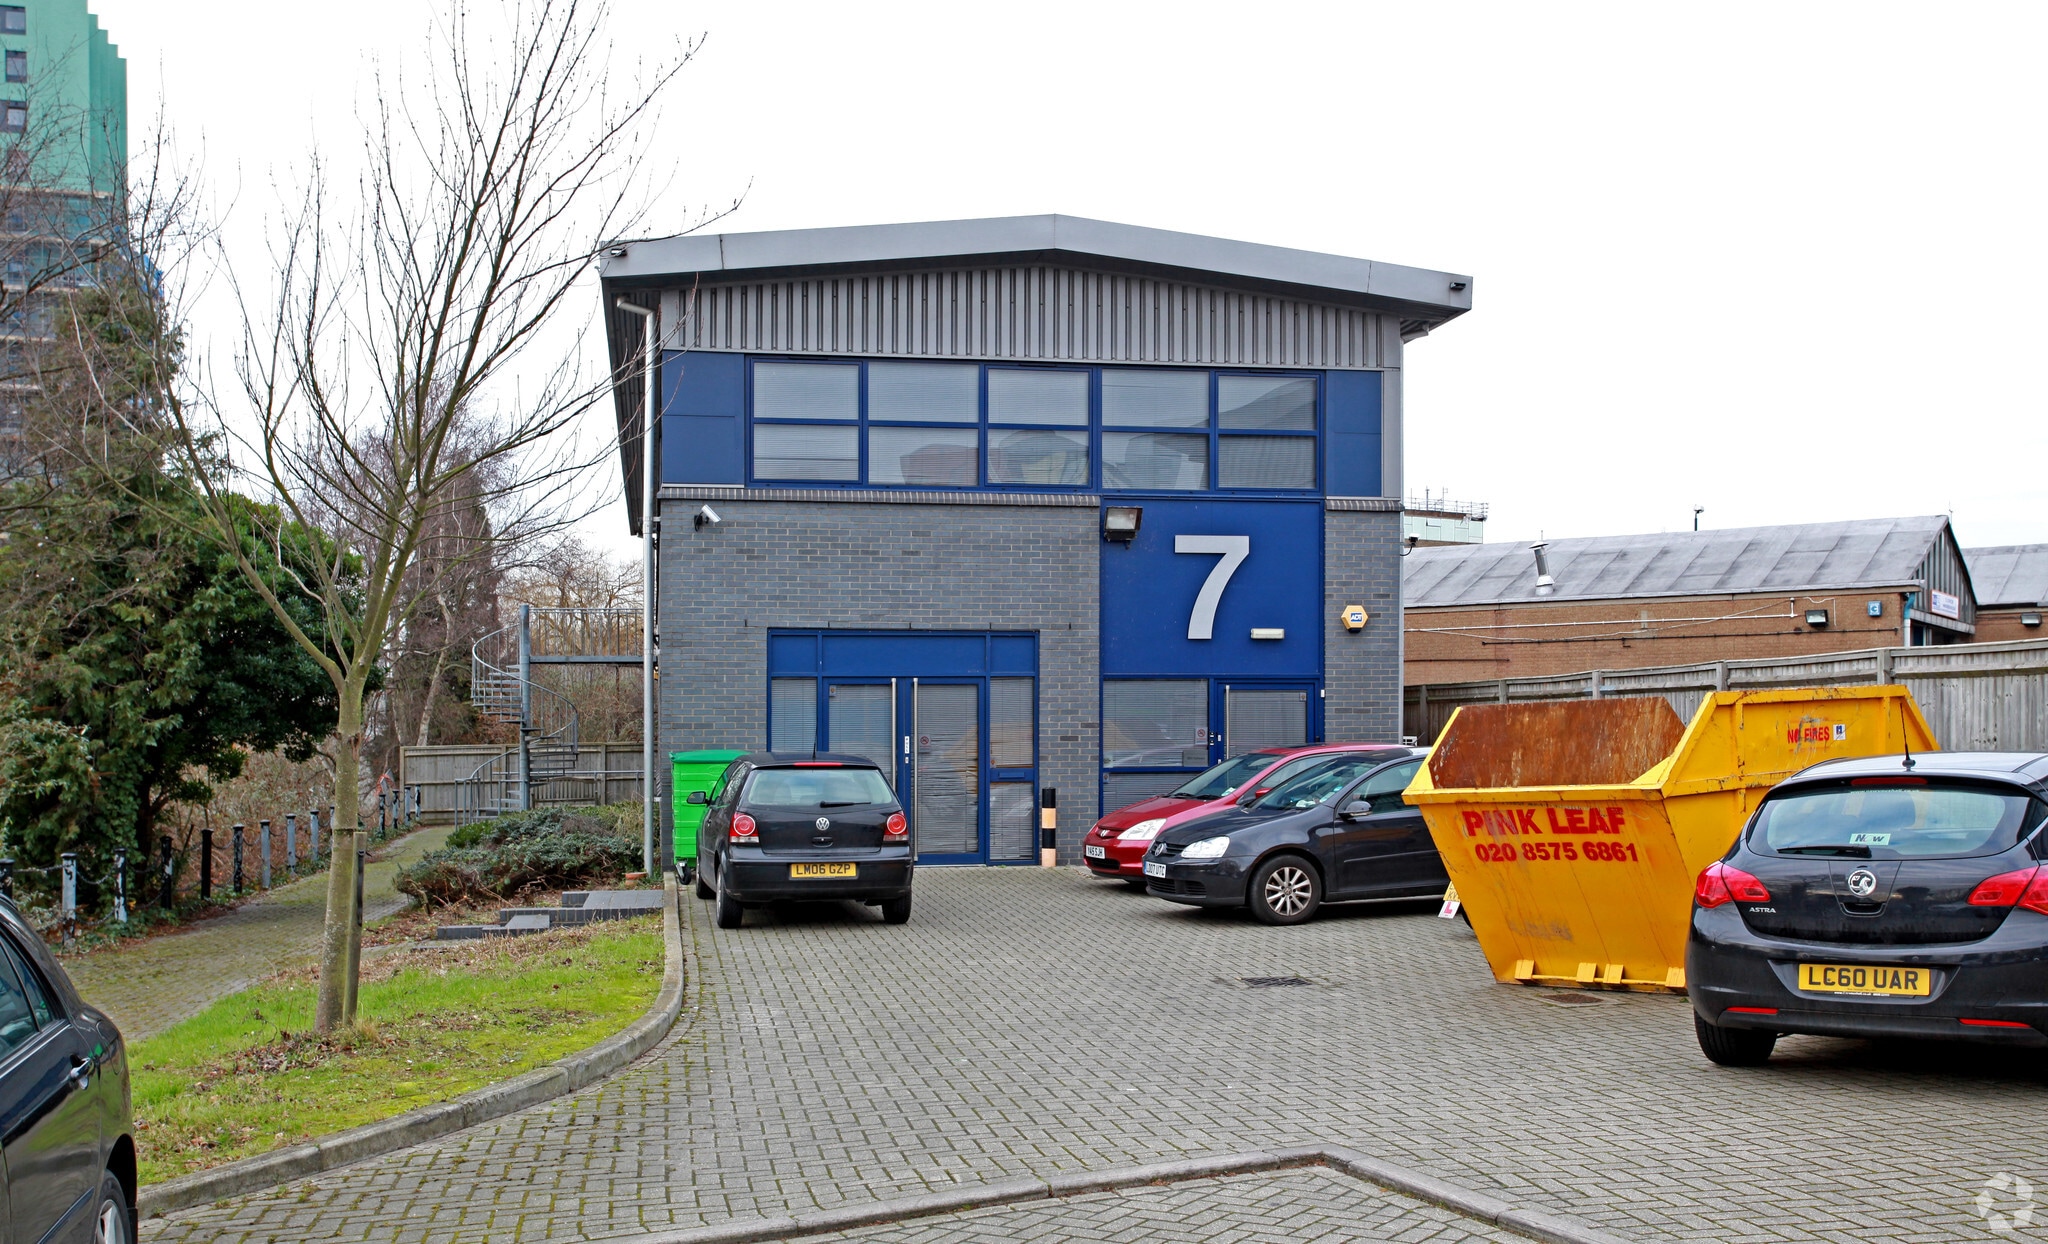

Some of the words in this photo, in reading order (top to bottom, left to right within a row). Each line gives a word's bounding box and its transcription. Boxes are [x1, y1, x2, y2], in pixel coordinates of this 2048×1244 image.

[1175, 535, 1249, 639] 7
[1804, 726, 1830, 742] FIRES
[1462, 808, 1543, 836] PINK
[1546, 807, 1625, 835] LEAF
[1475, 843, 1517, 862] 020
[1521, 842, 1578, 861] 8575
[1582, 841, 1638, 862] 6861
[796, 864, 825, 875] LM06
[829, 864, 850, 874] GZP
[1809, 967, 1866, 987] LC60
[1874, 969, 1918, 990] UAR
